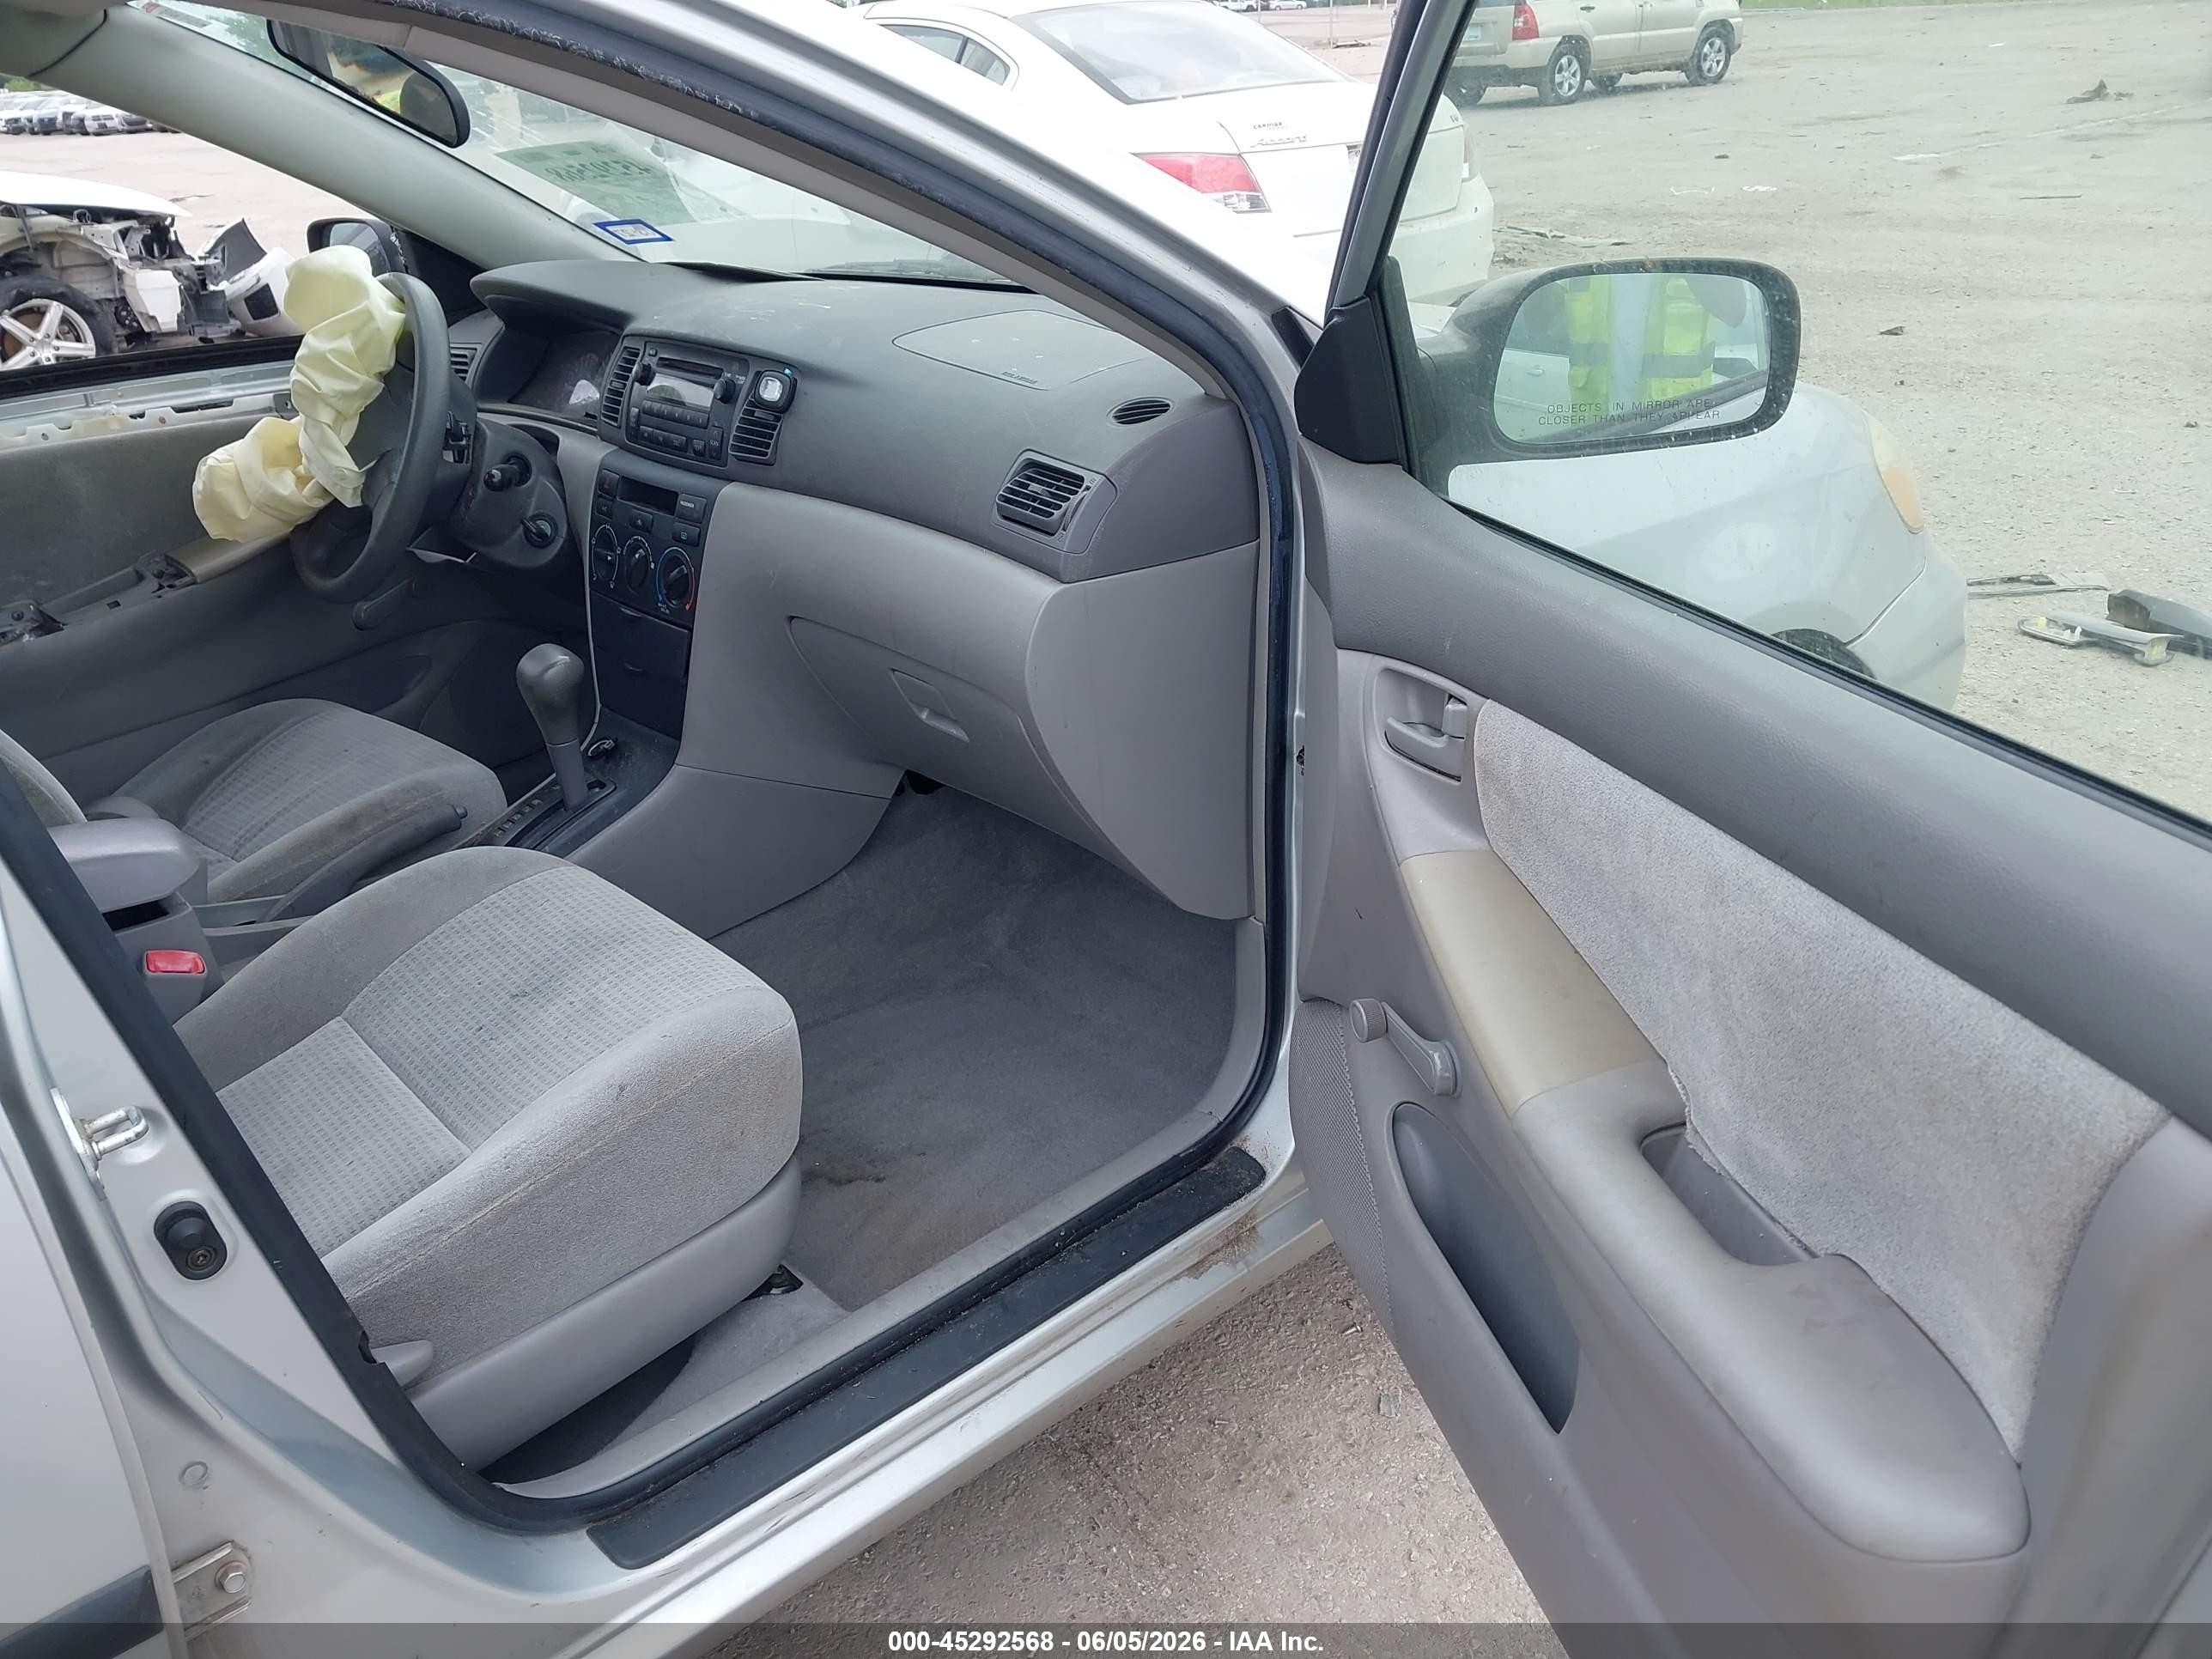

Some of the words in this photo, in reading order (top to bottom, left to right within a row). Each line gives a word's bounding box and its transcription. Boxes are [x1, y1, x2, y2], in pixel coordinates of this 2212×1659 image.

[1547, 402, 1602, 414] OBJECTS
[1613, 401, 1624, 411] IN
[1632, 399, 1680, 410] MIRROR
[1538, 415, 1586, 426] CLOSER
[1594, 413, 1626, 424] THAN
[1634, 411, 1664, 422] THEY
[1672, 409, 1720, 421] APPEAR
